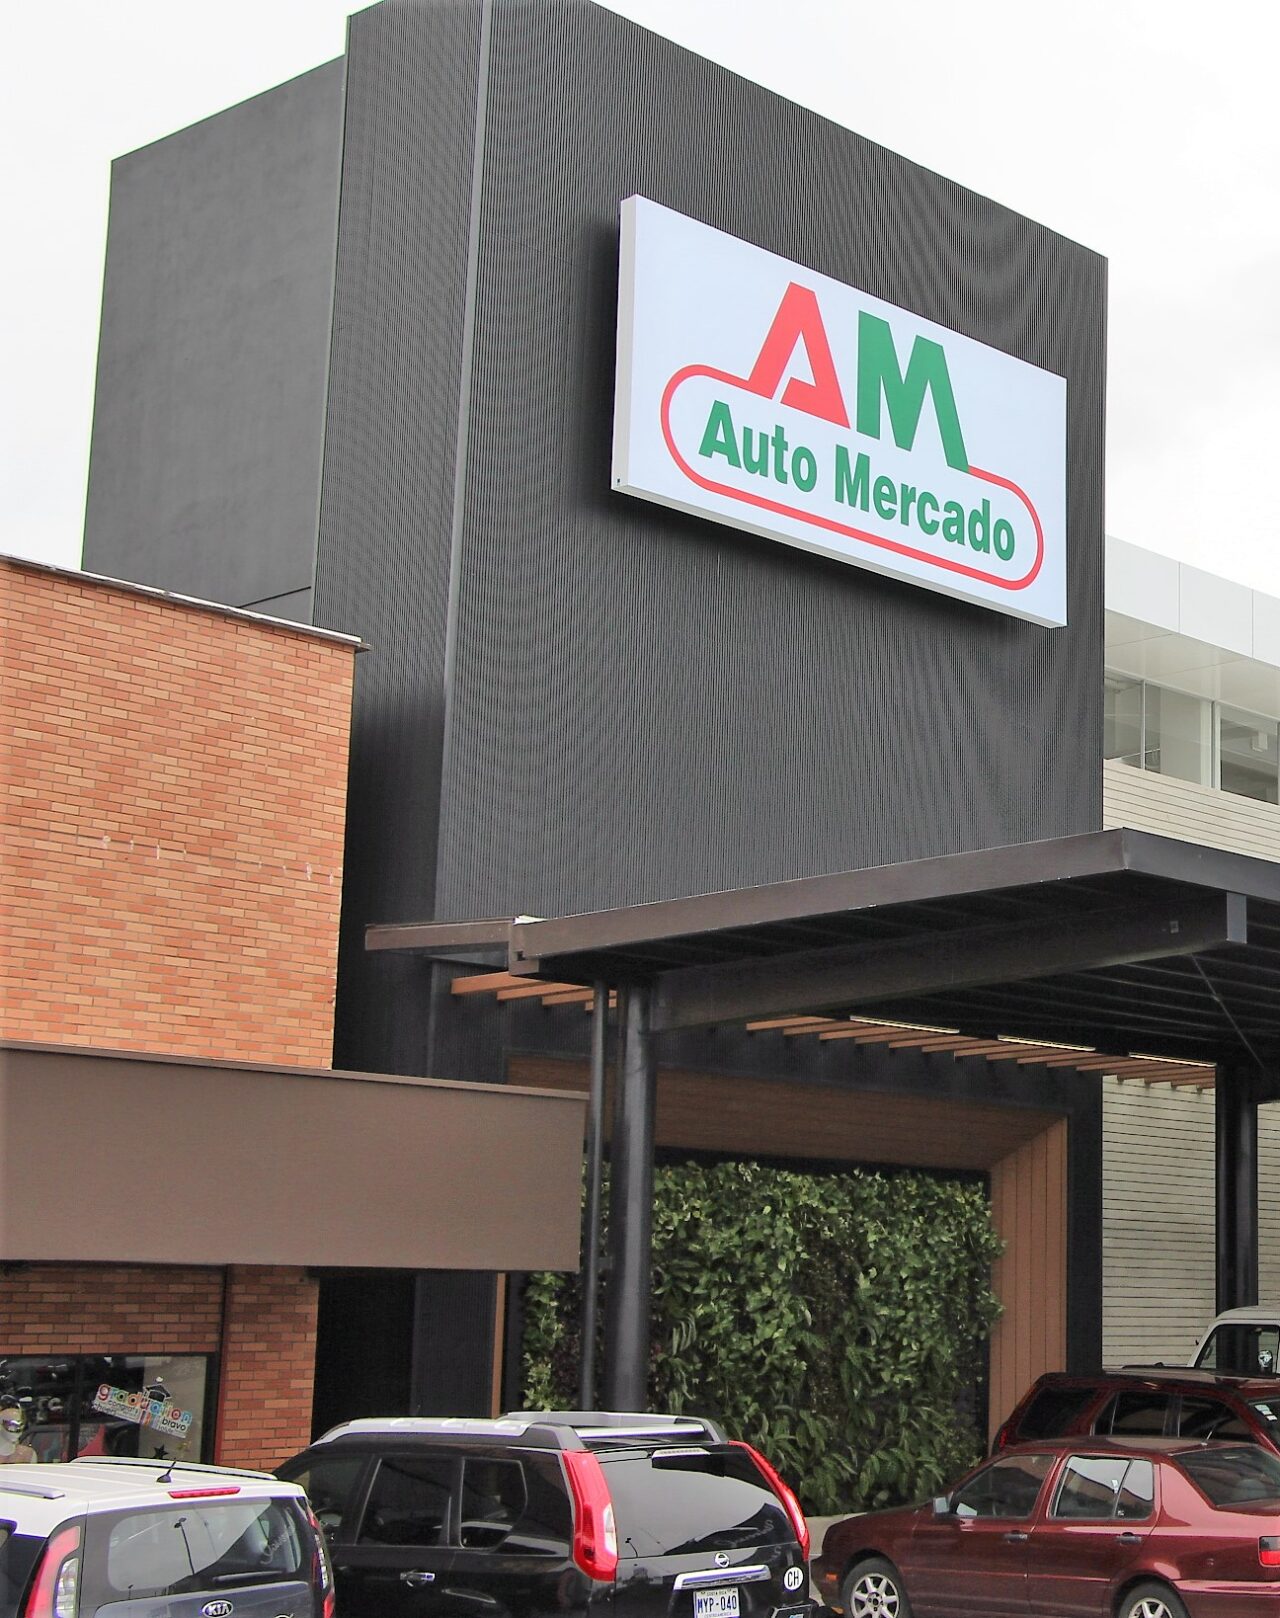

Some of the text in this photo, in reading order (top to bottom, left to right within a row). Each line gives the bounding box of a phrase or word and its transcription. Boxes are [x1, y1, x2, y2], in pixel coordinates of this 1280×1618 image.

[747, 281, 969, 475] AM
[698, 399, 1016, 562] Auto Mercado
[161, 1416, 187, 1432] bravo
[786, 1570, 800, 1588] CH
[208, 1603, 231, 1616] KIA
[697, 1594, 738, 1614] MYP-040
